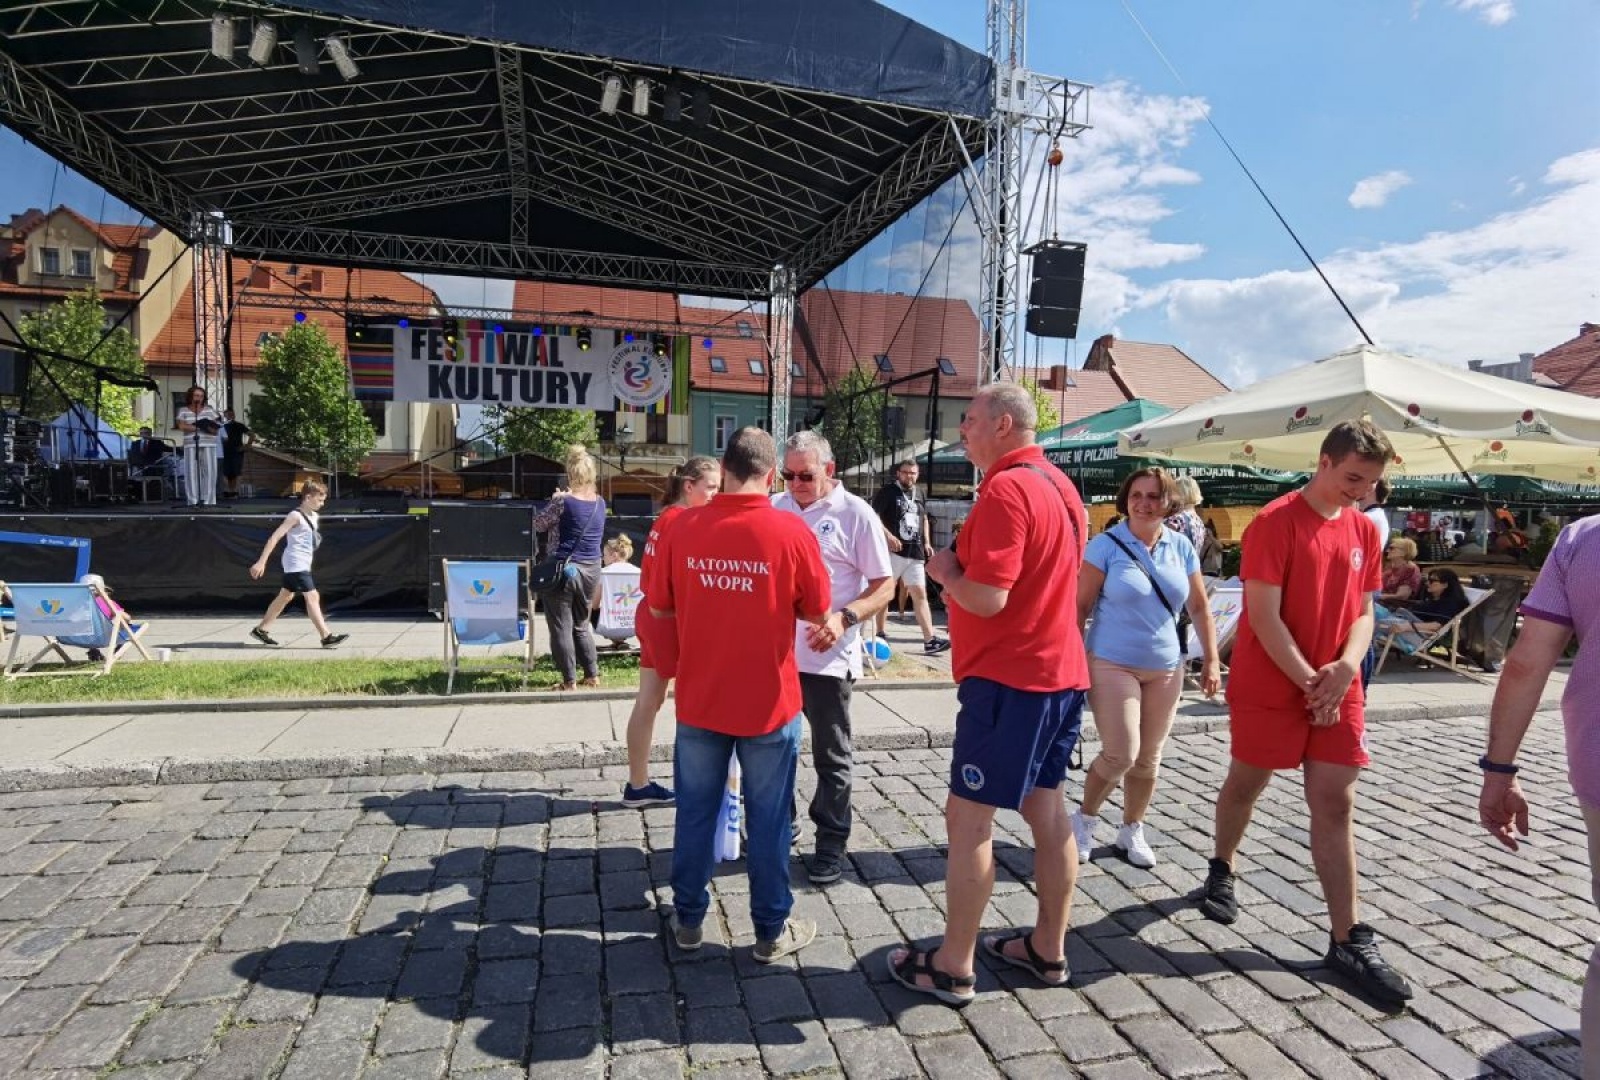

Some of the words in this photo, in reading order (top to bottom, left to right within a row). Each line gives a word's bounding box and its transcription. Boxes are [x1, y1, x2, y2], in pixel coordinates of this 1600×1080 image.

[411, 328, 563, 367] FESTIWAL
[428, 364, 592, 405] KULTURY
[1074, 449, 1084, 463] W
[687, 556, 769, 576] RATOWNIK
[700, 573, 753, 592] WOPR
